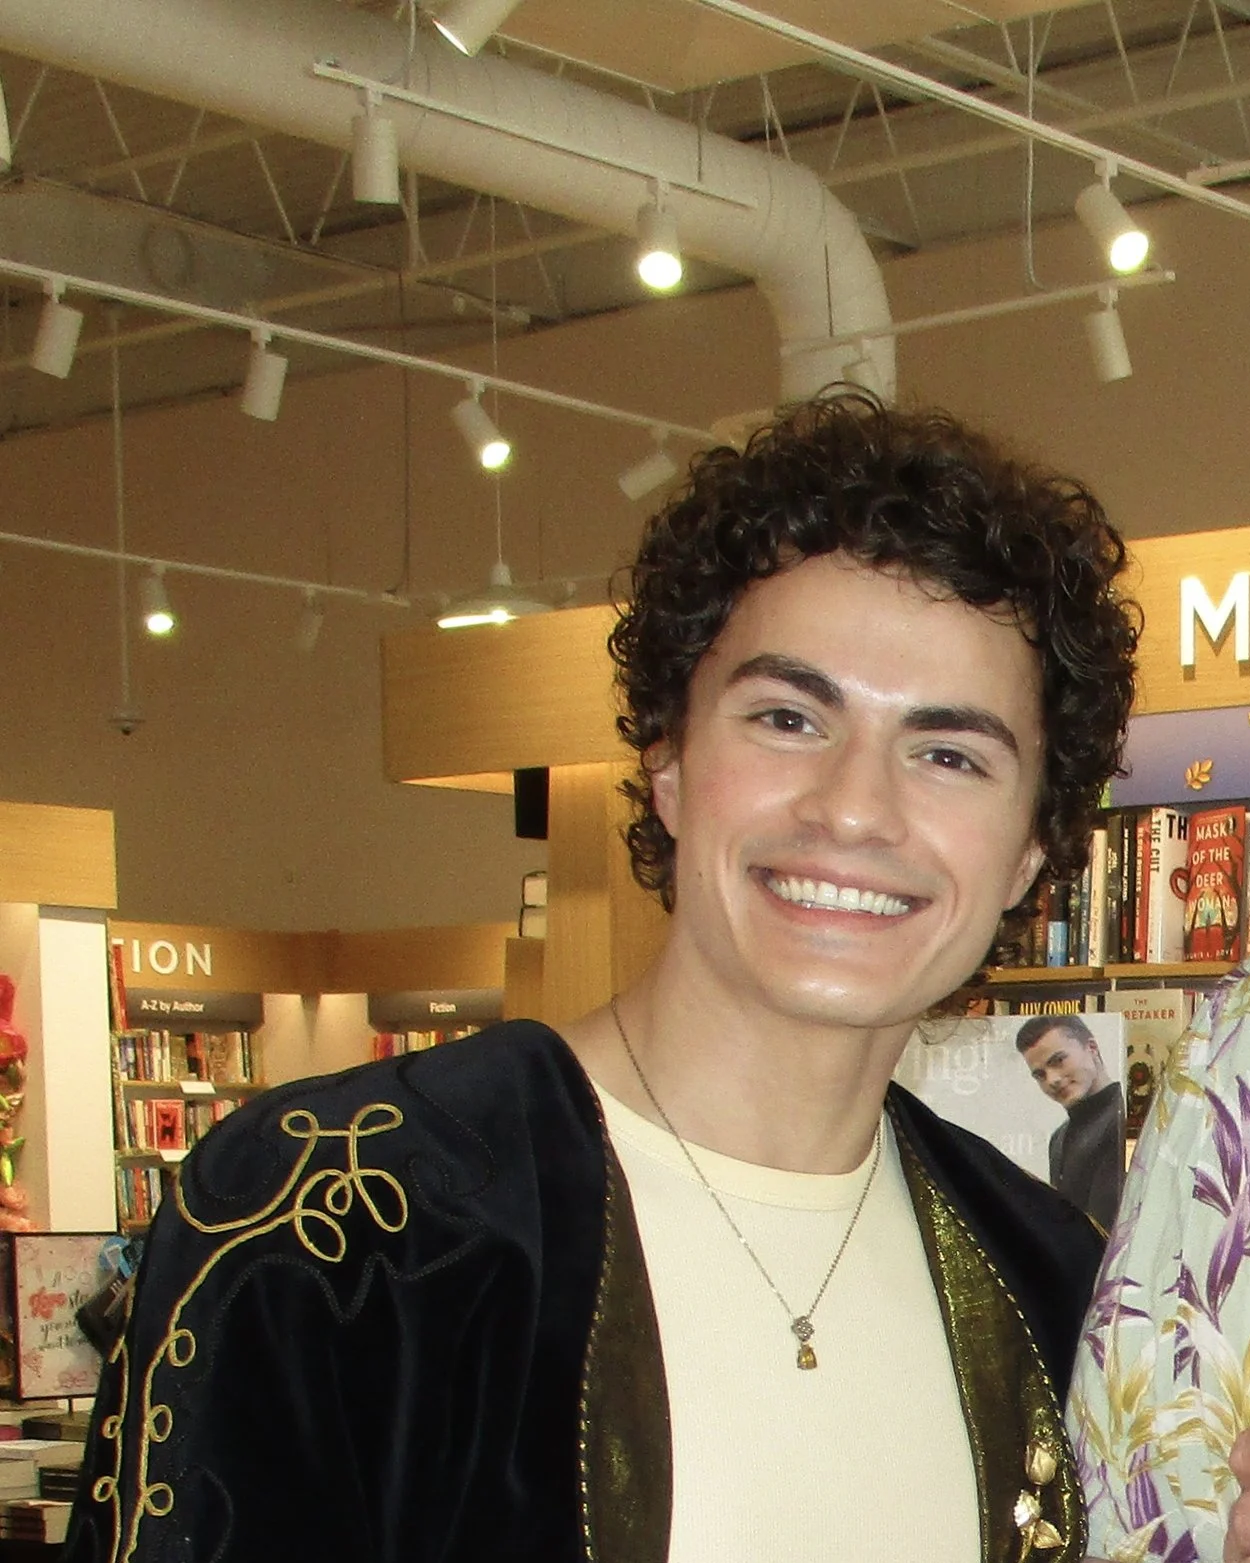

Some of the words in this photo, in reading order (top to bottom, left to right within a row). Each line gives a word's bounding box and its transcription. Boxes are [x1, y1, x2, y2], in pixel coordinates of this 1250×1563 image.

[1196, 822, 1228, 841] MASK
[1192, 850, 1206, 864] OF
[1210, 847, 1230, 861] THE
[1196, 872, 1223, 888] DEER
[1189, 895, 1231, 911] WOMAN
[1124, 1009, 1176, 1020] RETAKER
